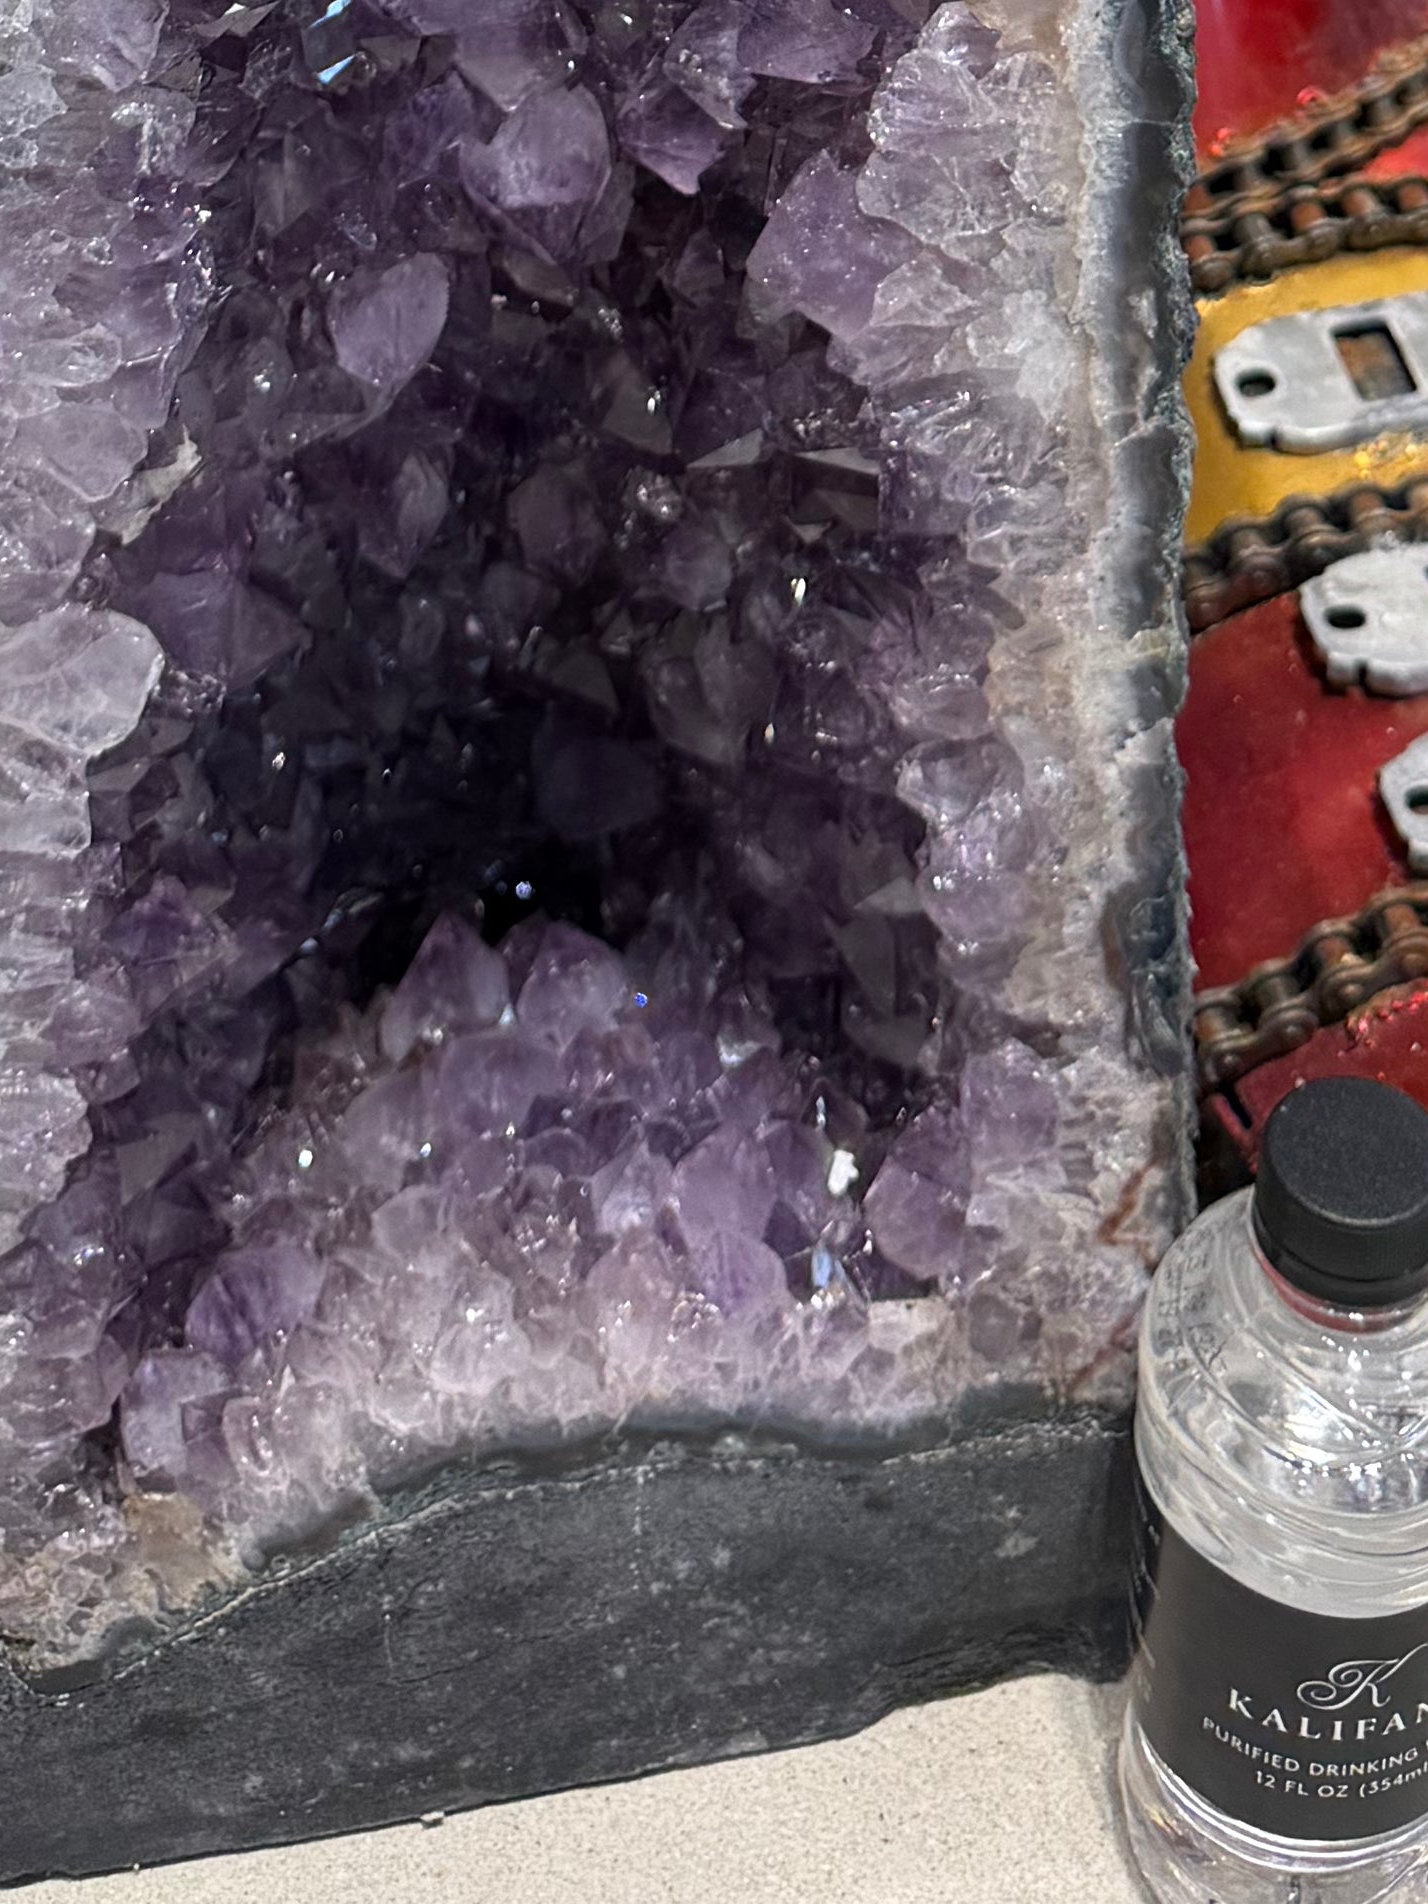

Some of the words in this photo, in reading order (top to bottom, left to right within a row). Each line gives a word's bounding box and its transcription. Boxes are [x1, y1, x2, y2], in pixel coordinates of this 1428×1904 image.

[1202, 1716, 1301, 1772] PURIFIED
[1308, 1747, 1419, 1777] DRINKING
[1255, 1770, 1276, 1790] 12
[1284, 1779, 1309, 1797] FL
[1317, 1784, 1349, 1799] OZ
